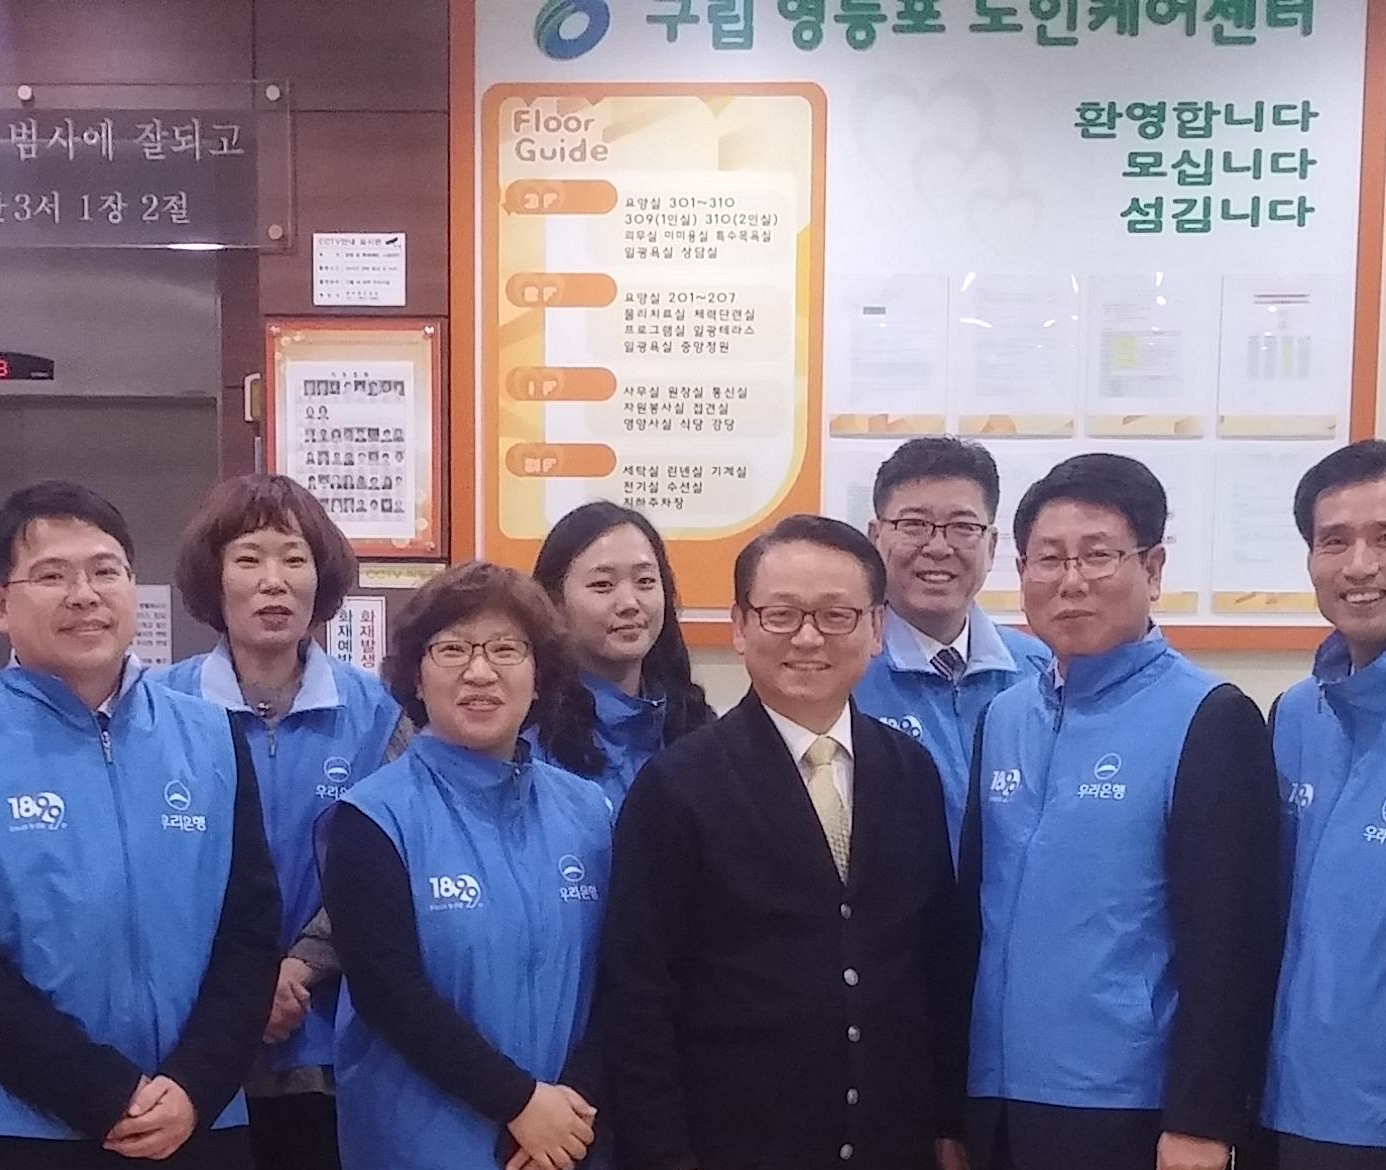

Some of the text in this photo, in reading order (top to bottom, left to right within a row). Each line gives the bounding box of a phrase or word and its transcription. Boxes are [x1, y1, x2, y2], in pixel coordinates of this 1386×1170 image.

[645, 0, 1314, 52] 구립 영등포 노인케어센터
[513, 108, 596, 133] Floor
[1073, 99, 1320, 140] 환영합니다
[8, 116, 114, 162] 범사에
[132, 117, 245, 162] 잘되고
[515, 137, 609, 163] Guide
[1121, 148, 1318, 187] 모십니다
[79, 191, 128, 225] 1장
[141, 190, 191, 225] 2절
[625, 196, 736, 210] 요양실 301~310
[624, 213, 779, 227] 309(1인실) 310(2인실)
[625, 291, 737, 305] 요양실 201~207
[624, 324, 686, 338] 프로그램실
[623, 386, 660, 399] 사무실
[623, 402, 730, 416] 자원봉사실 접견실
[623, 418, 735, 432] 영양사실 식당 강당
[622, 465, 660, 479] 세탁실
[710, 465, 748, 479] 기계실
[623, 481, 660, 495] 전기실
[622, 497, 685, 510] 지하주차장
[1076, 782, 1126, 802] 우리은행
[160, 813, 207, 832] 우리은행
